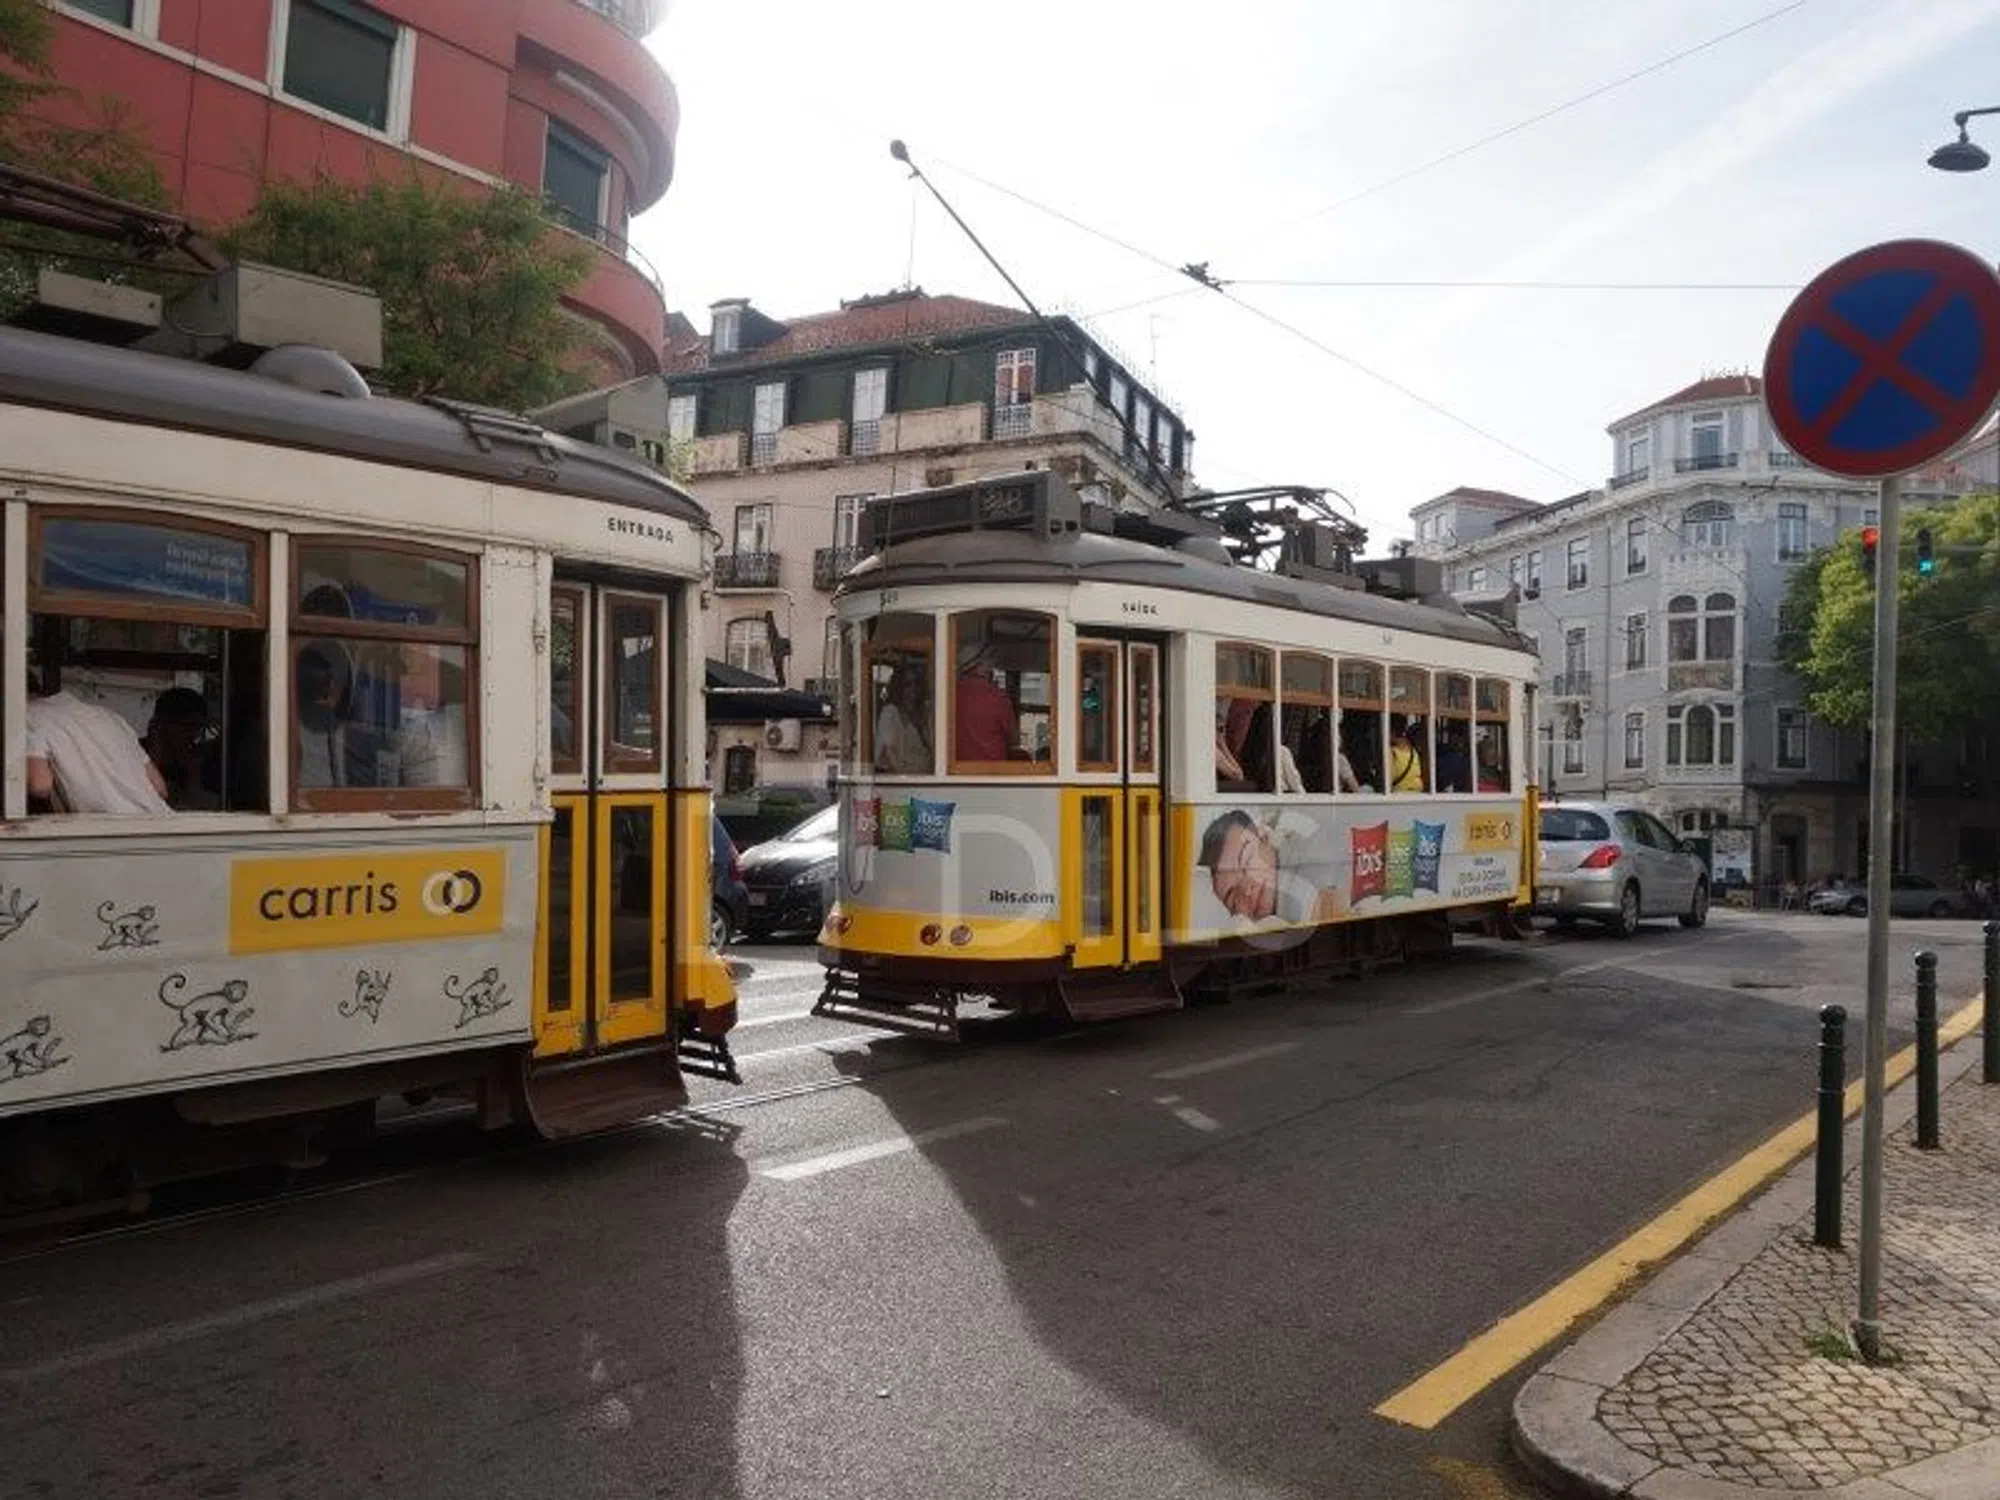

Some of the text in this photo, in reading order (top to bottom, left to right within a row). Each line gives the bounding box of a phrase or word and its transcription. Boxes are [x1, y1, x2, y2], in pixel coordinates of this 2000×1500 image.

[607, 517, 674, 543] ENTRADA
[1356, 845, 1384, 877] ibis
[259, 870, 398, 921] carris
[989, 889, 1055, 904] ibis.com
